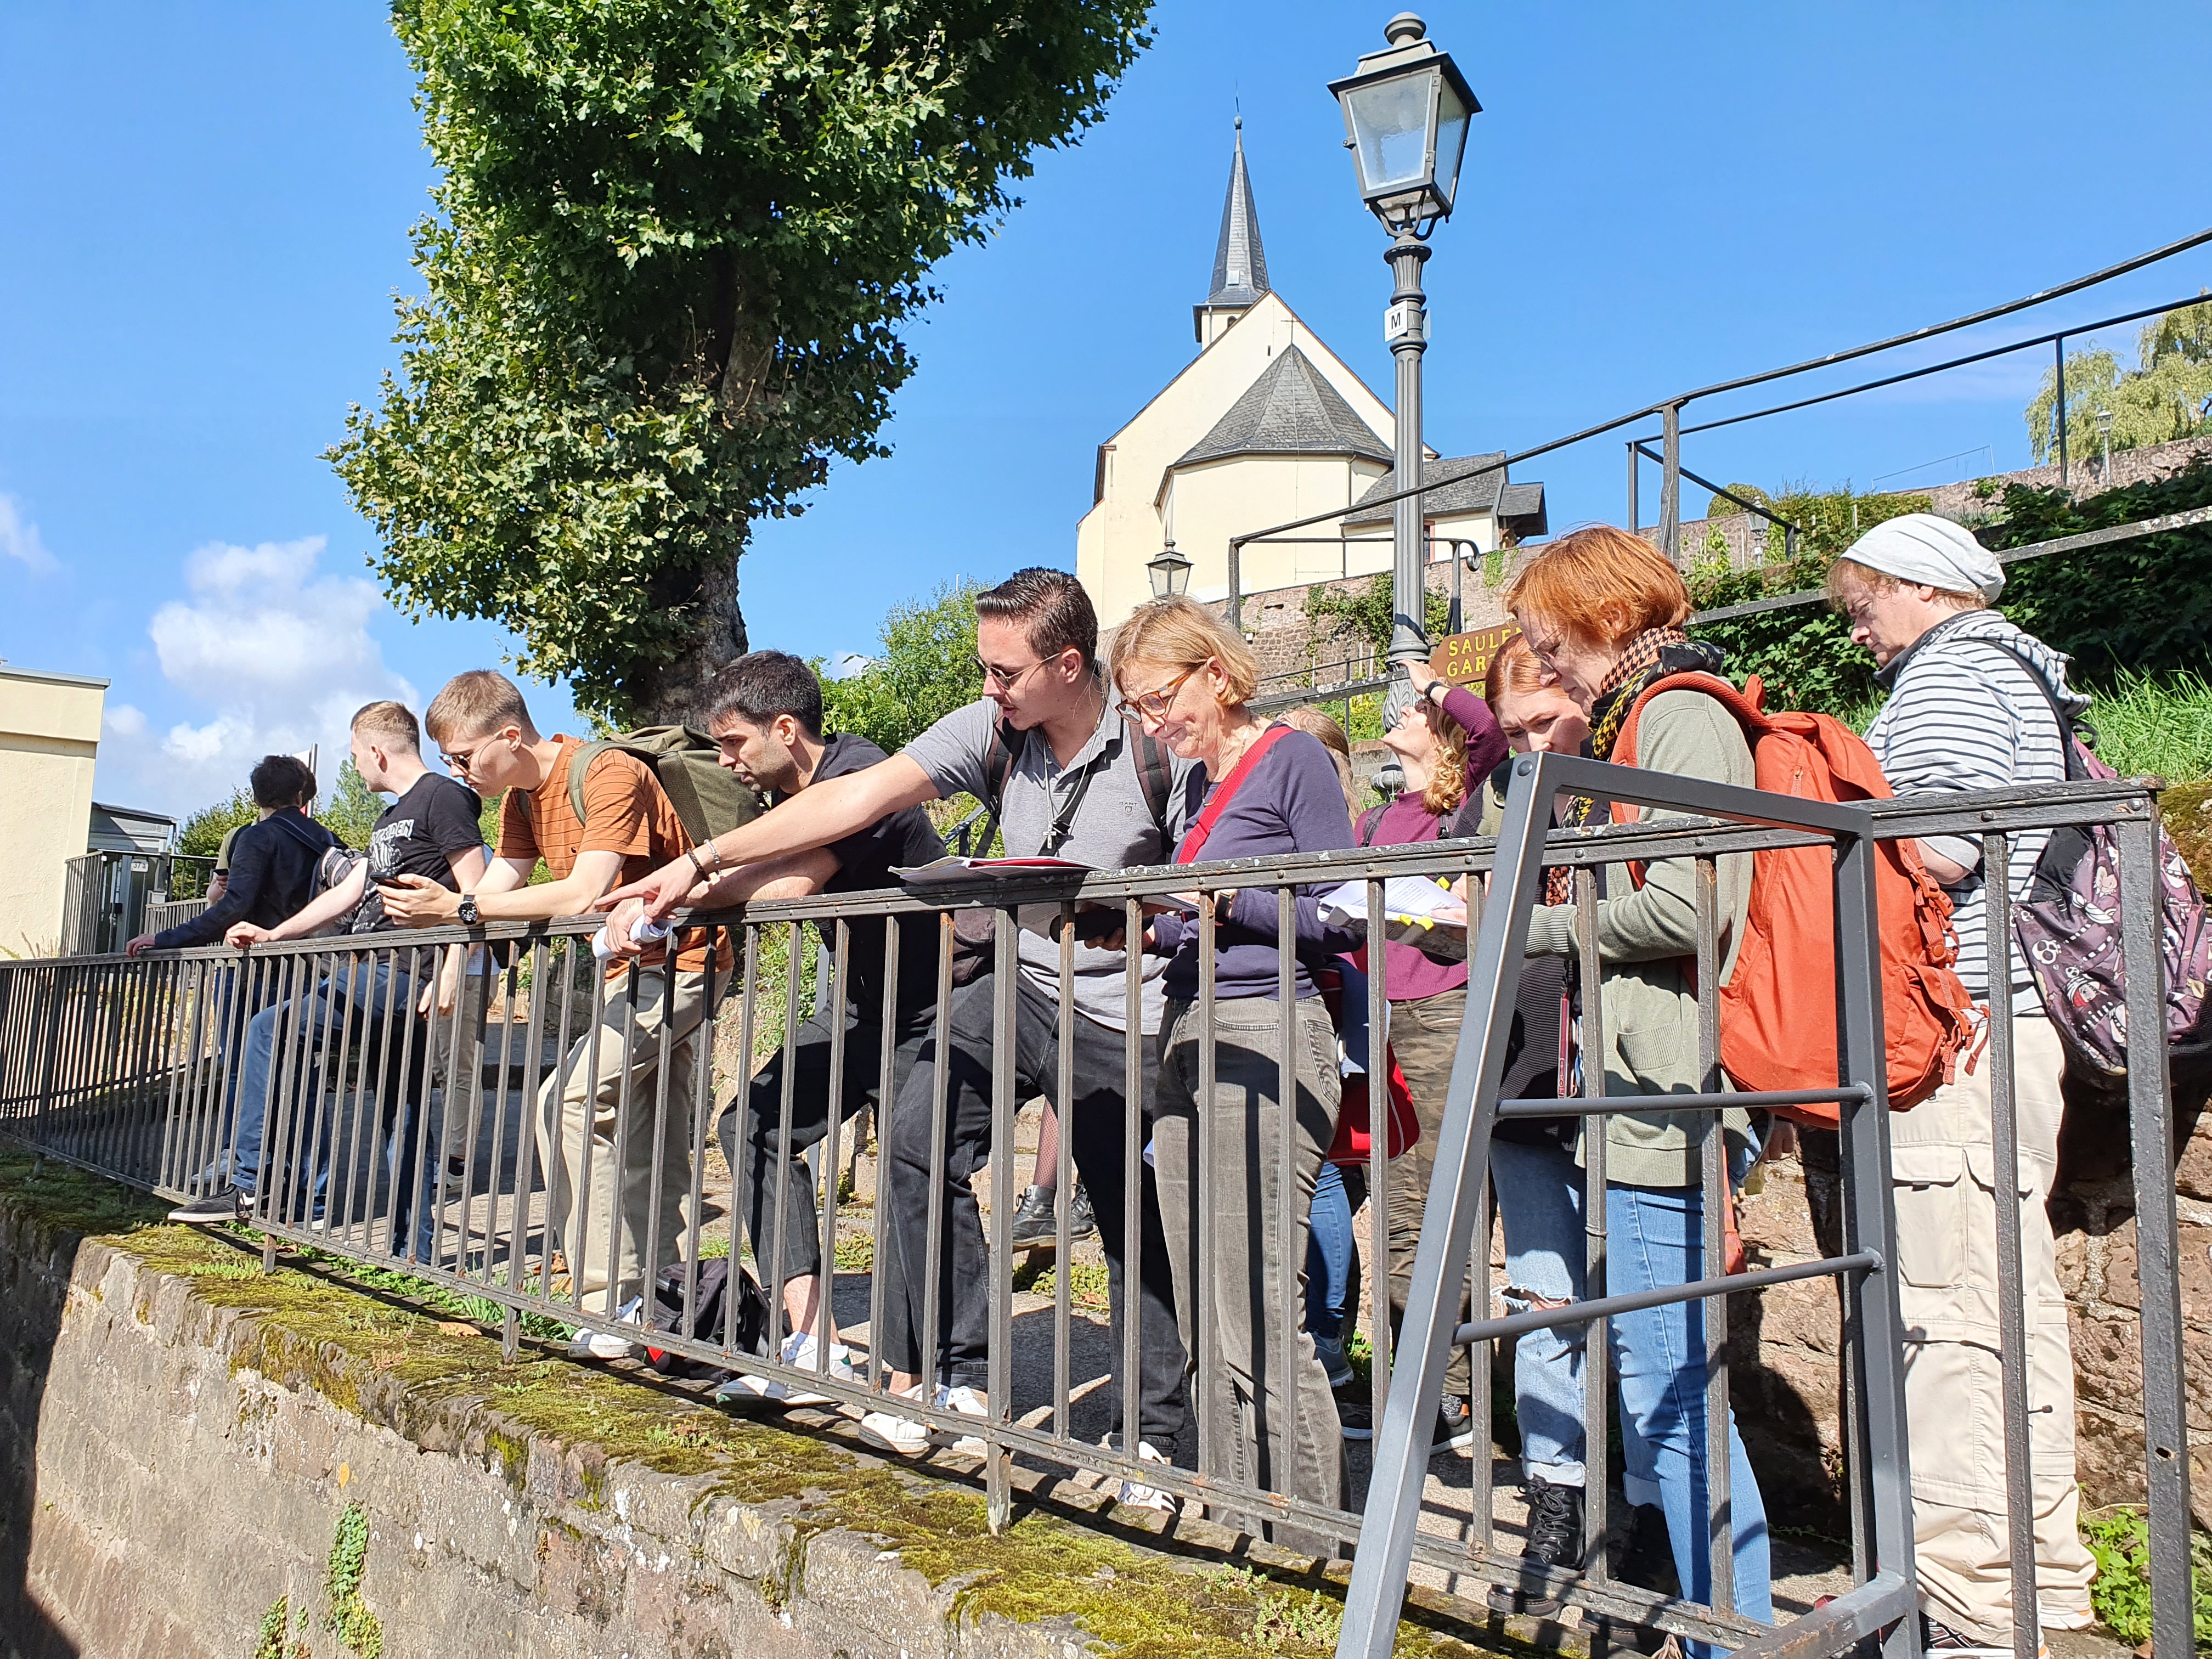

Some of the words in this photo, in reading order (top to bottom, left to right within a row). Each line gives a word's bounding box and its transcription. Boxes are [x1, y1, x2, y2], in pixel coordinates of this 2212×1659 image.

[1391, 312, 1401, 330] M
[1448, 627, 1522, 657] SÄULE
[1447, 653, 1496, 677] GAR
